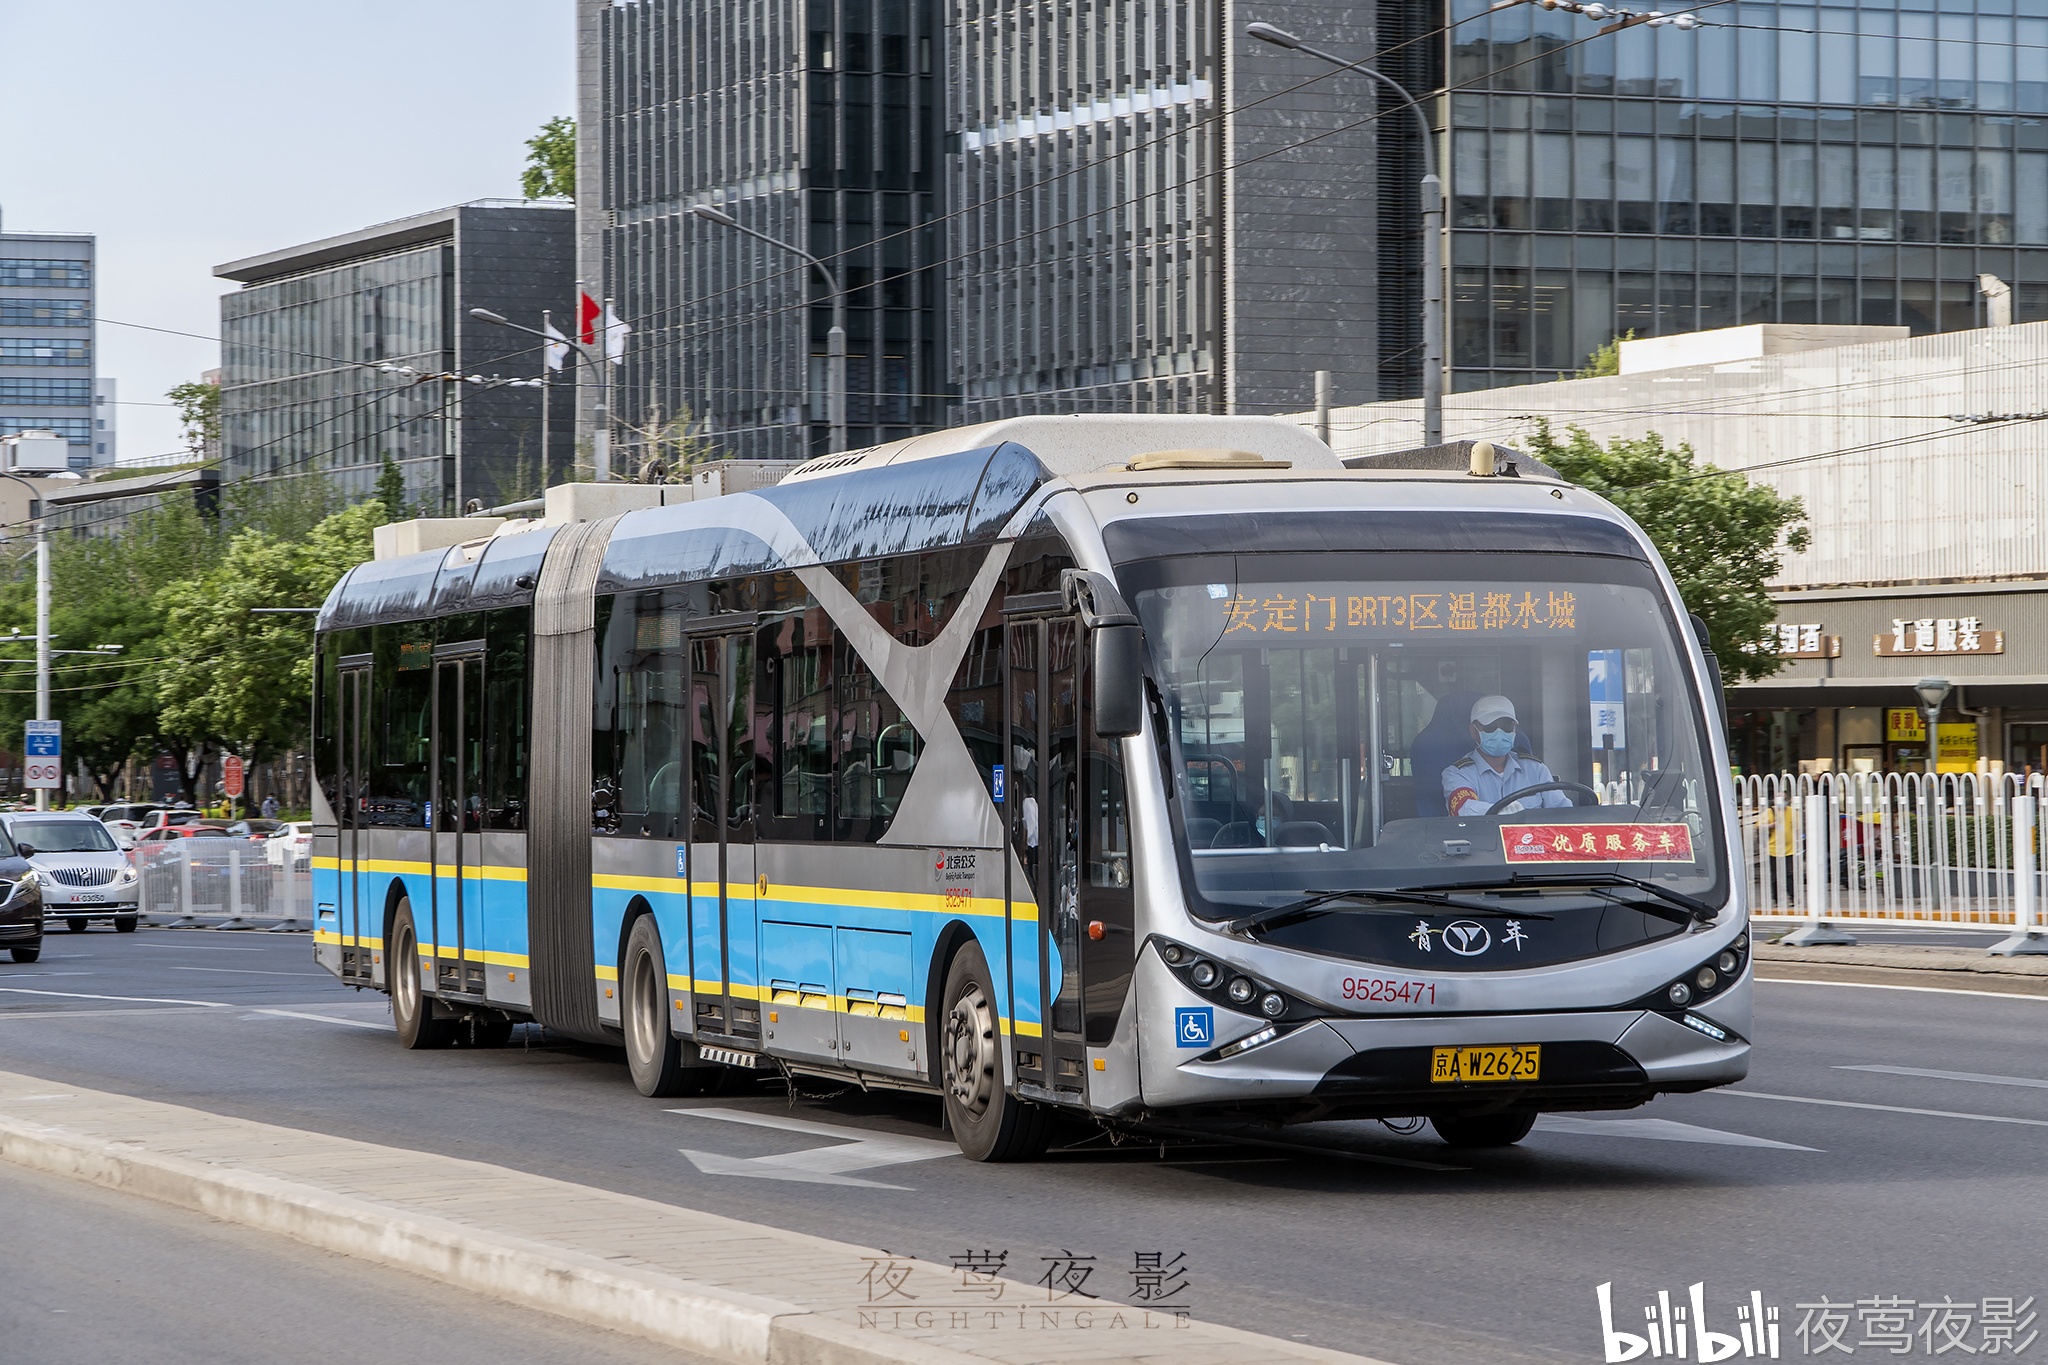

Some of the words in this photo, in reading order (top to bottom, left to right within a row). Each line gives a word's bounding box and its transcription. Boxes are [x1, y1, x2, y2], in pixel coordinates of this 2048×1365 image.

[1222, 593, 1337, 633] 安定门
[1347, 593, 1444, 631] BRT3区
[1447, 590, 1577, 630] 温都水城
[1892, 616, 1981, 653] 汇通服装
[1551, 831, 1676, 855] 优质服务车
[946, 855, 976, 869] 北京公交
[946, 888, 972, 907] 9525471
[1342, 977, 1437, 1005] 9525471
